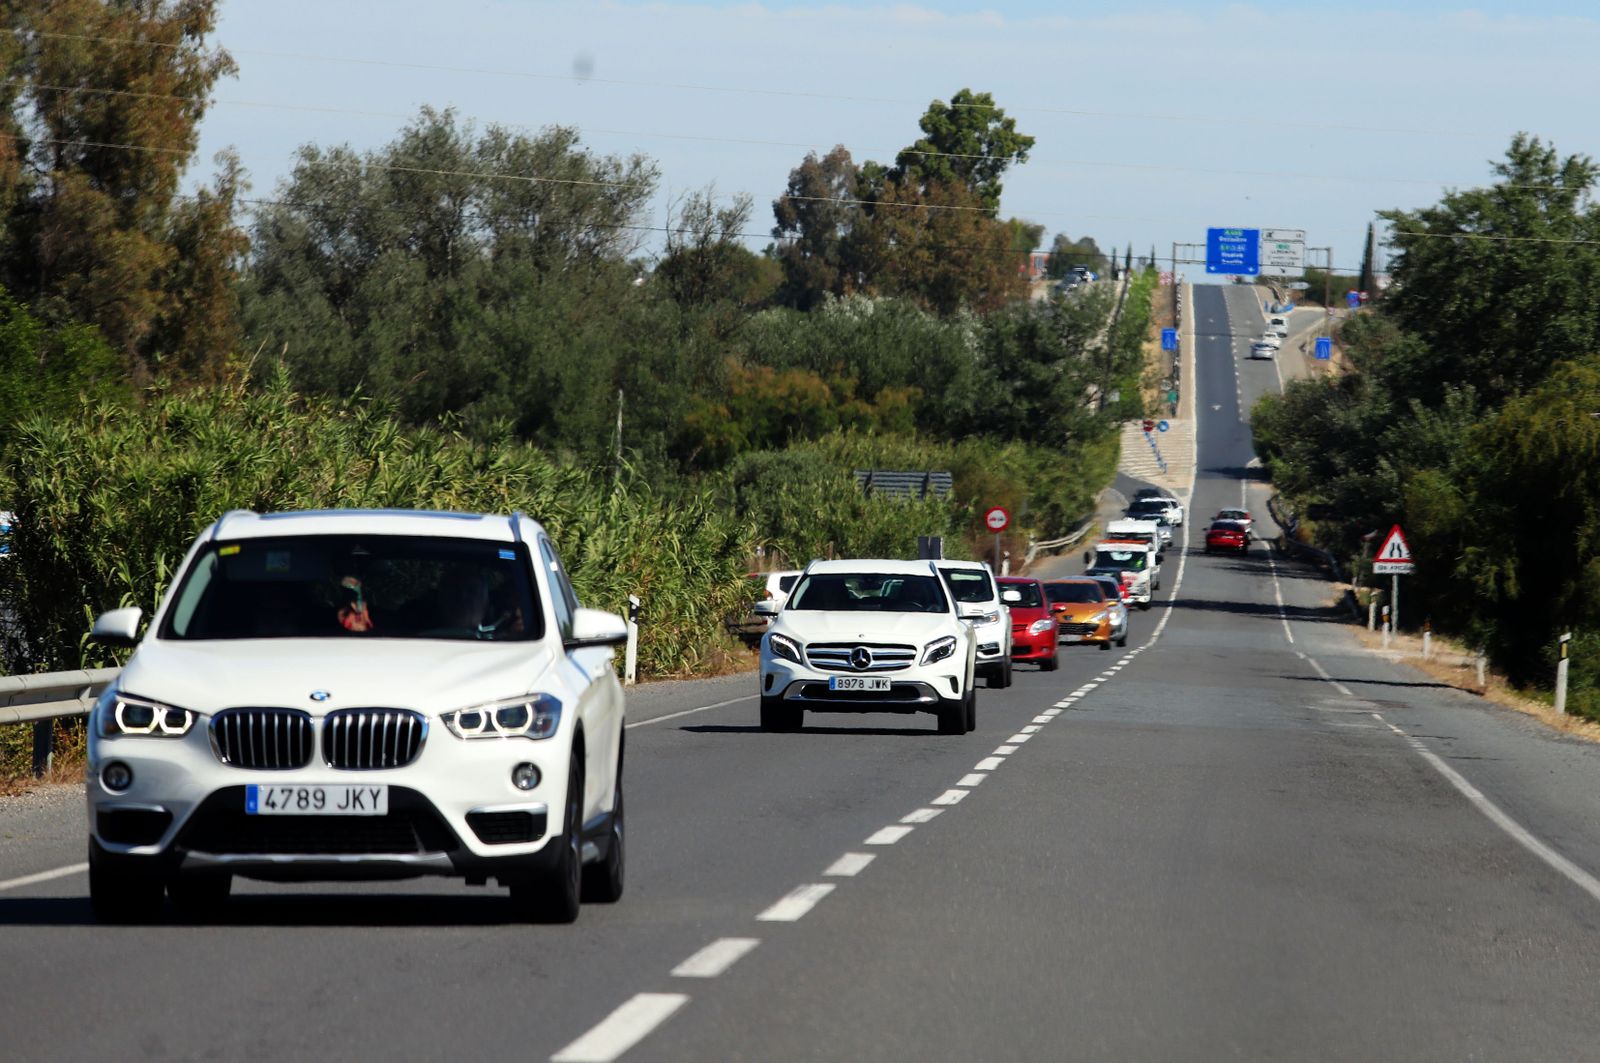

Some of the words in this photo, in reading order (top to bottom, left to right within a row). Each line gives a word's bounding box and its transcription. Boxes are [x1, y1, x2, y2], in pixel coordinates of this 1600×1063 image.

[837, 679, 865, 689] 8978
[868, 679, 888, 689] JWK
[264, 787, 326, 810] 4789
[337, 788, 381, 810] JKY
